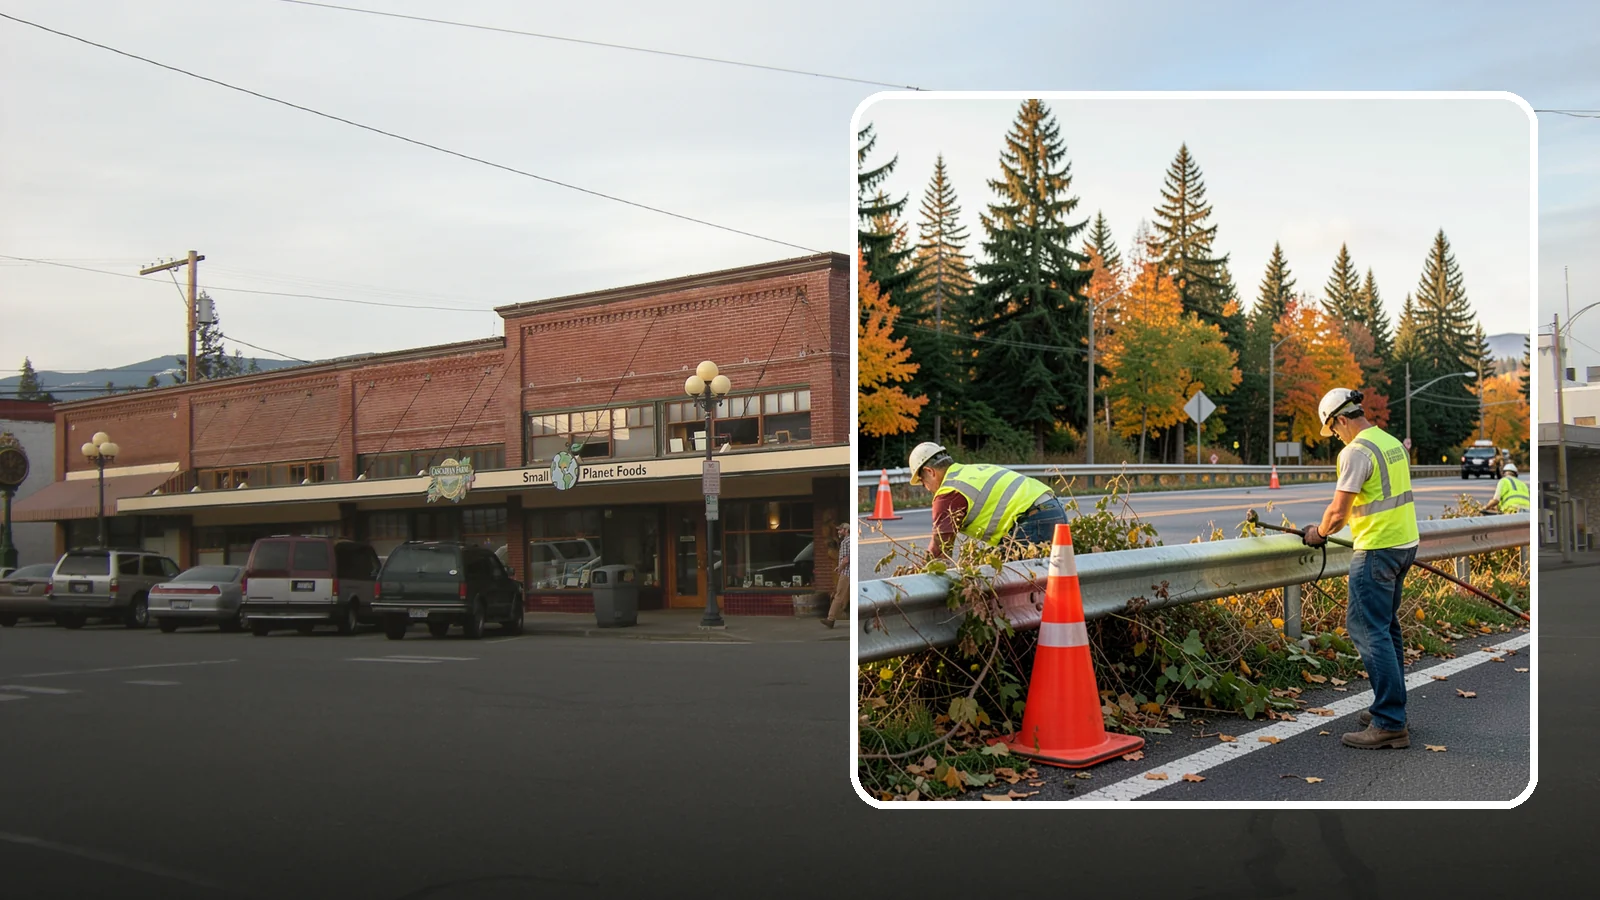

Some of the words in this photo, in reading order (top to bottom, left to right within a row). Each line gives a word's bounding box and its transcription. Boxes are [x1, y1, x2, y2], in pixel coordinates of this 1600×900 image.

[523, 471, 549, 483] Small
[583, 468, 614, 479] Planet
[616, 464, 647, 477] Foods
